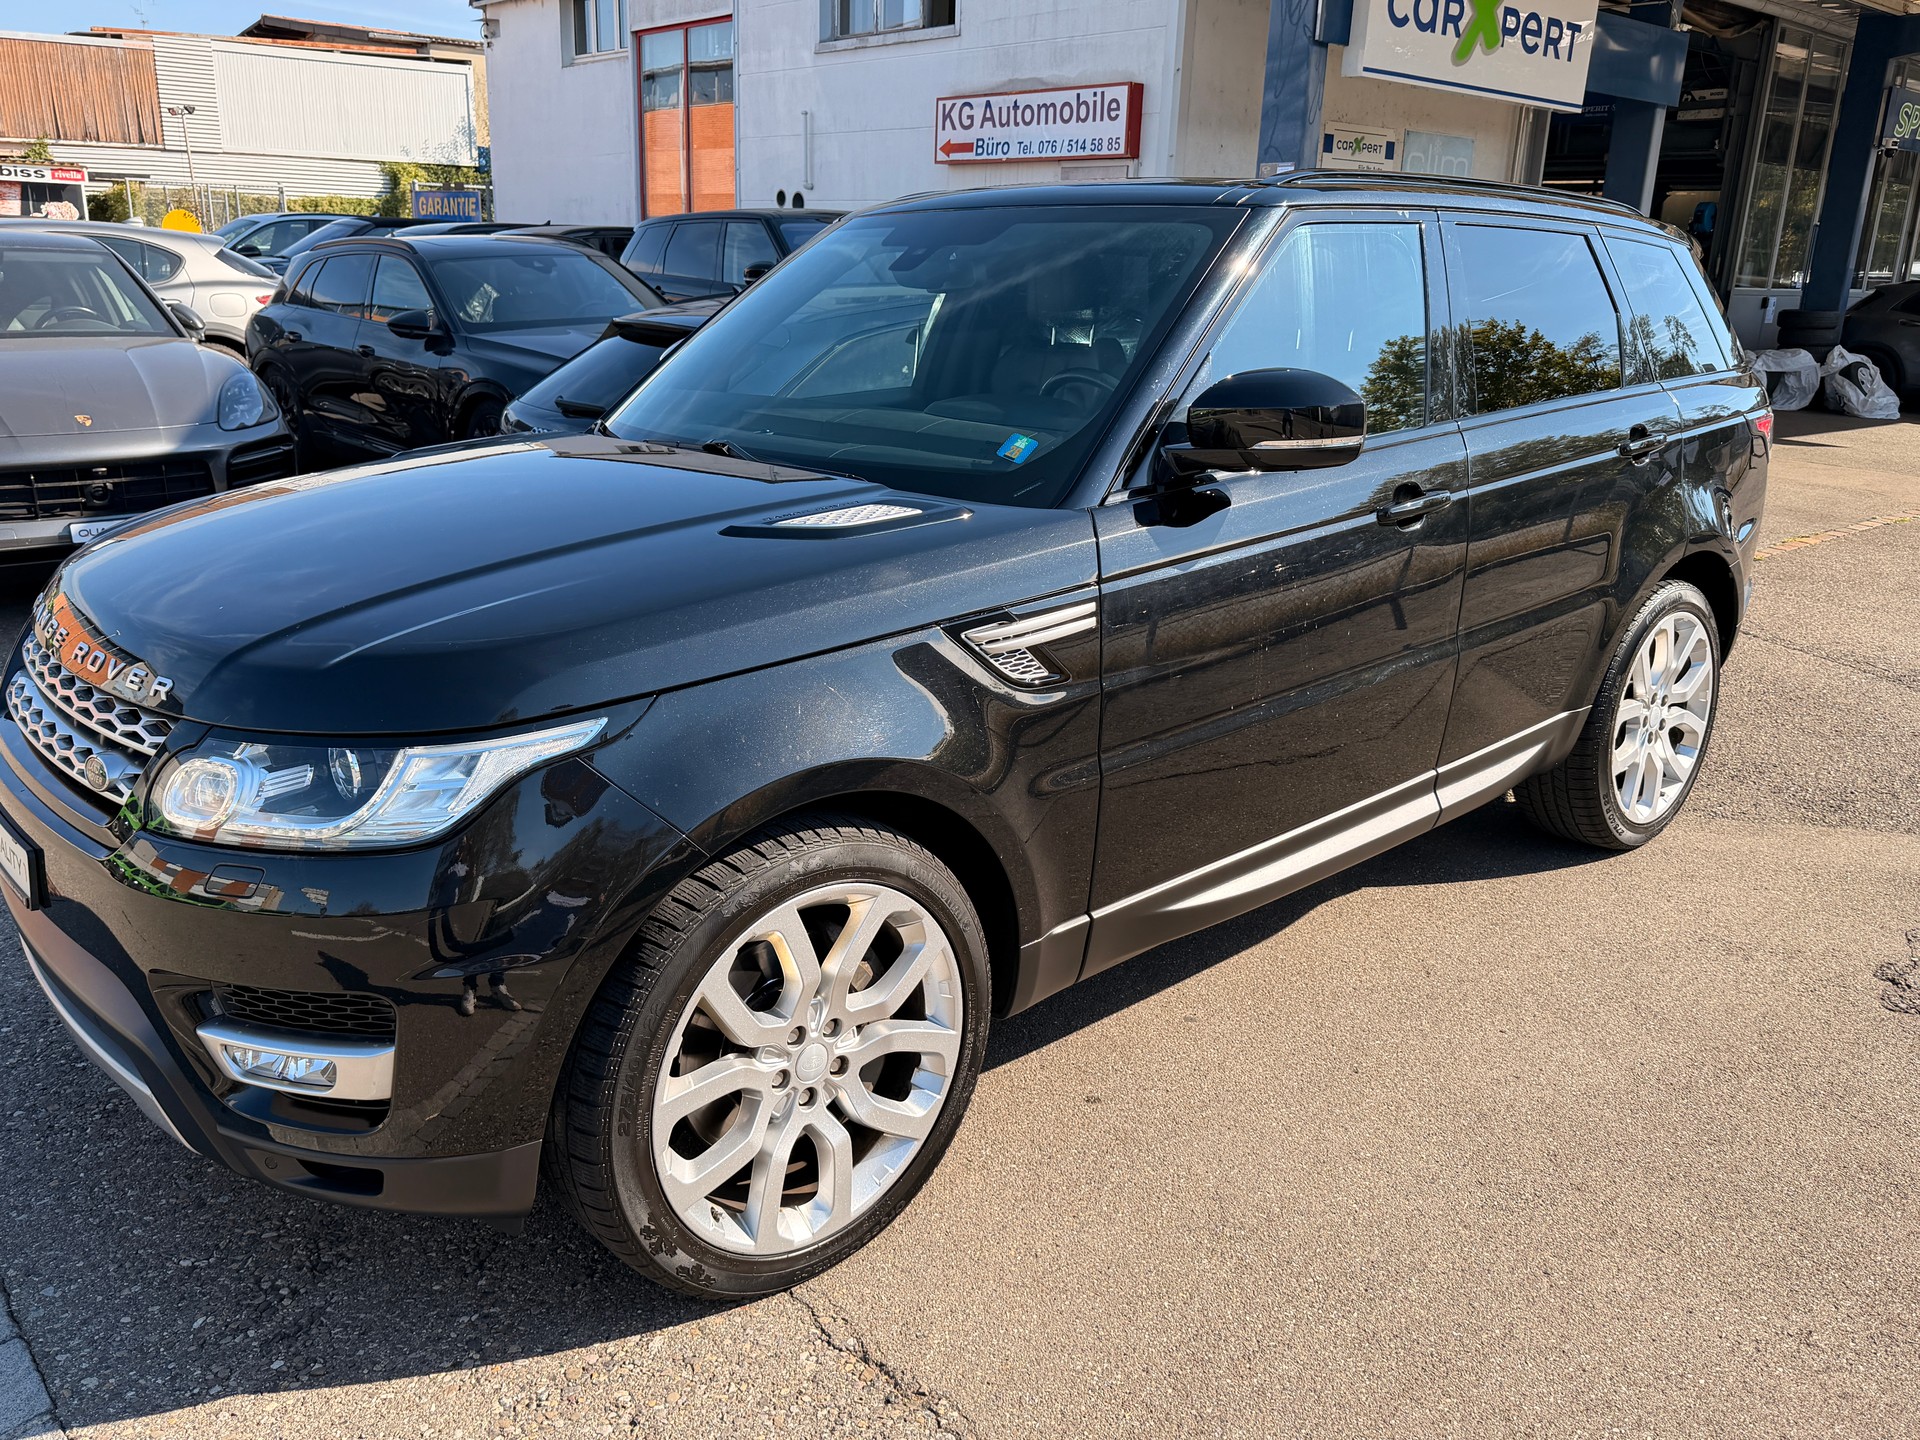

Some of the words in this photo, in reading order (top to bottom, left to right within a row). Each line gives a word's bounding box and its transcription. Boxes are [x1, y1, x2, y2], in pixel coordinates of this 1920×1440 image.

[941, 102, 975, 131] KG
[979, 91, 1121, 129] Automobile
[1893, 102, 1920, 140] SP
[975, 137, 1010, 157] Büro
[1017, 141, 1035, 155] Tel.
[1038, 139, 1057, 154] 076
[1066, 138, 1087, 153] 514
[1090, 138, 1104, 153] 58
[1107, 136, 1121, 152] 85
[1407, 143, 1469, 177] clim
[54, 169, 82, 179] rivella
[418, 196, 477, 217] GARANTIE
[71, 641, 174, 701] ROVER
